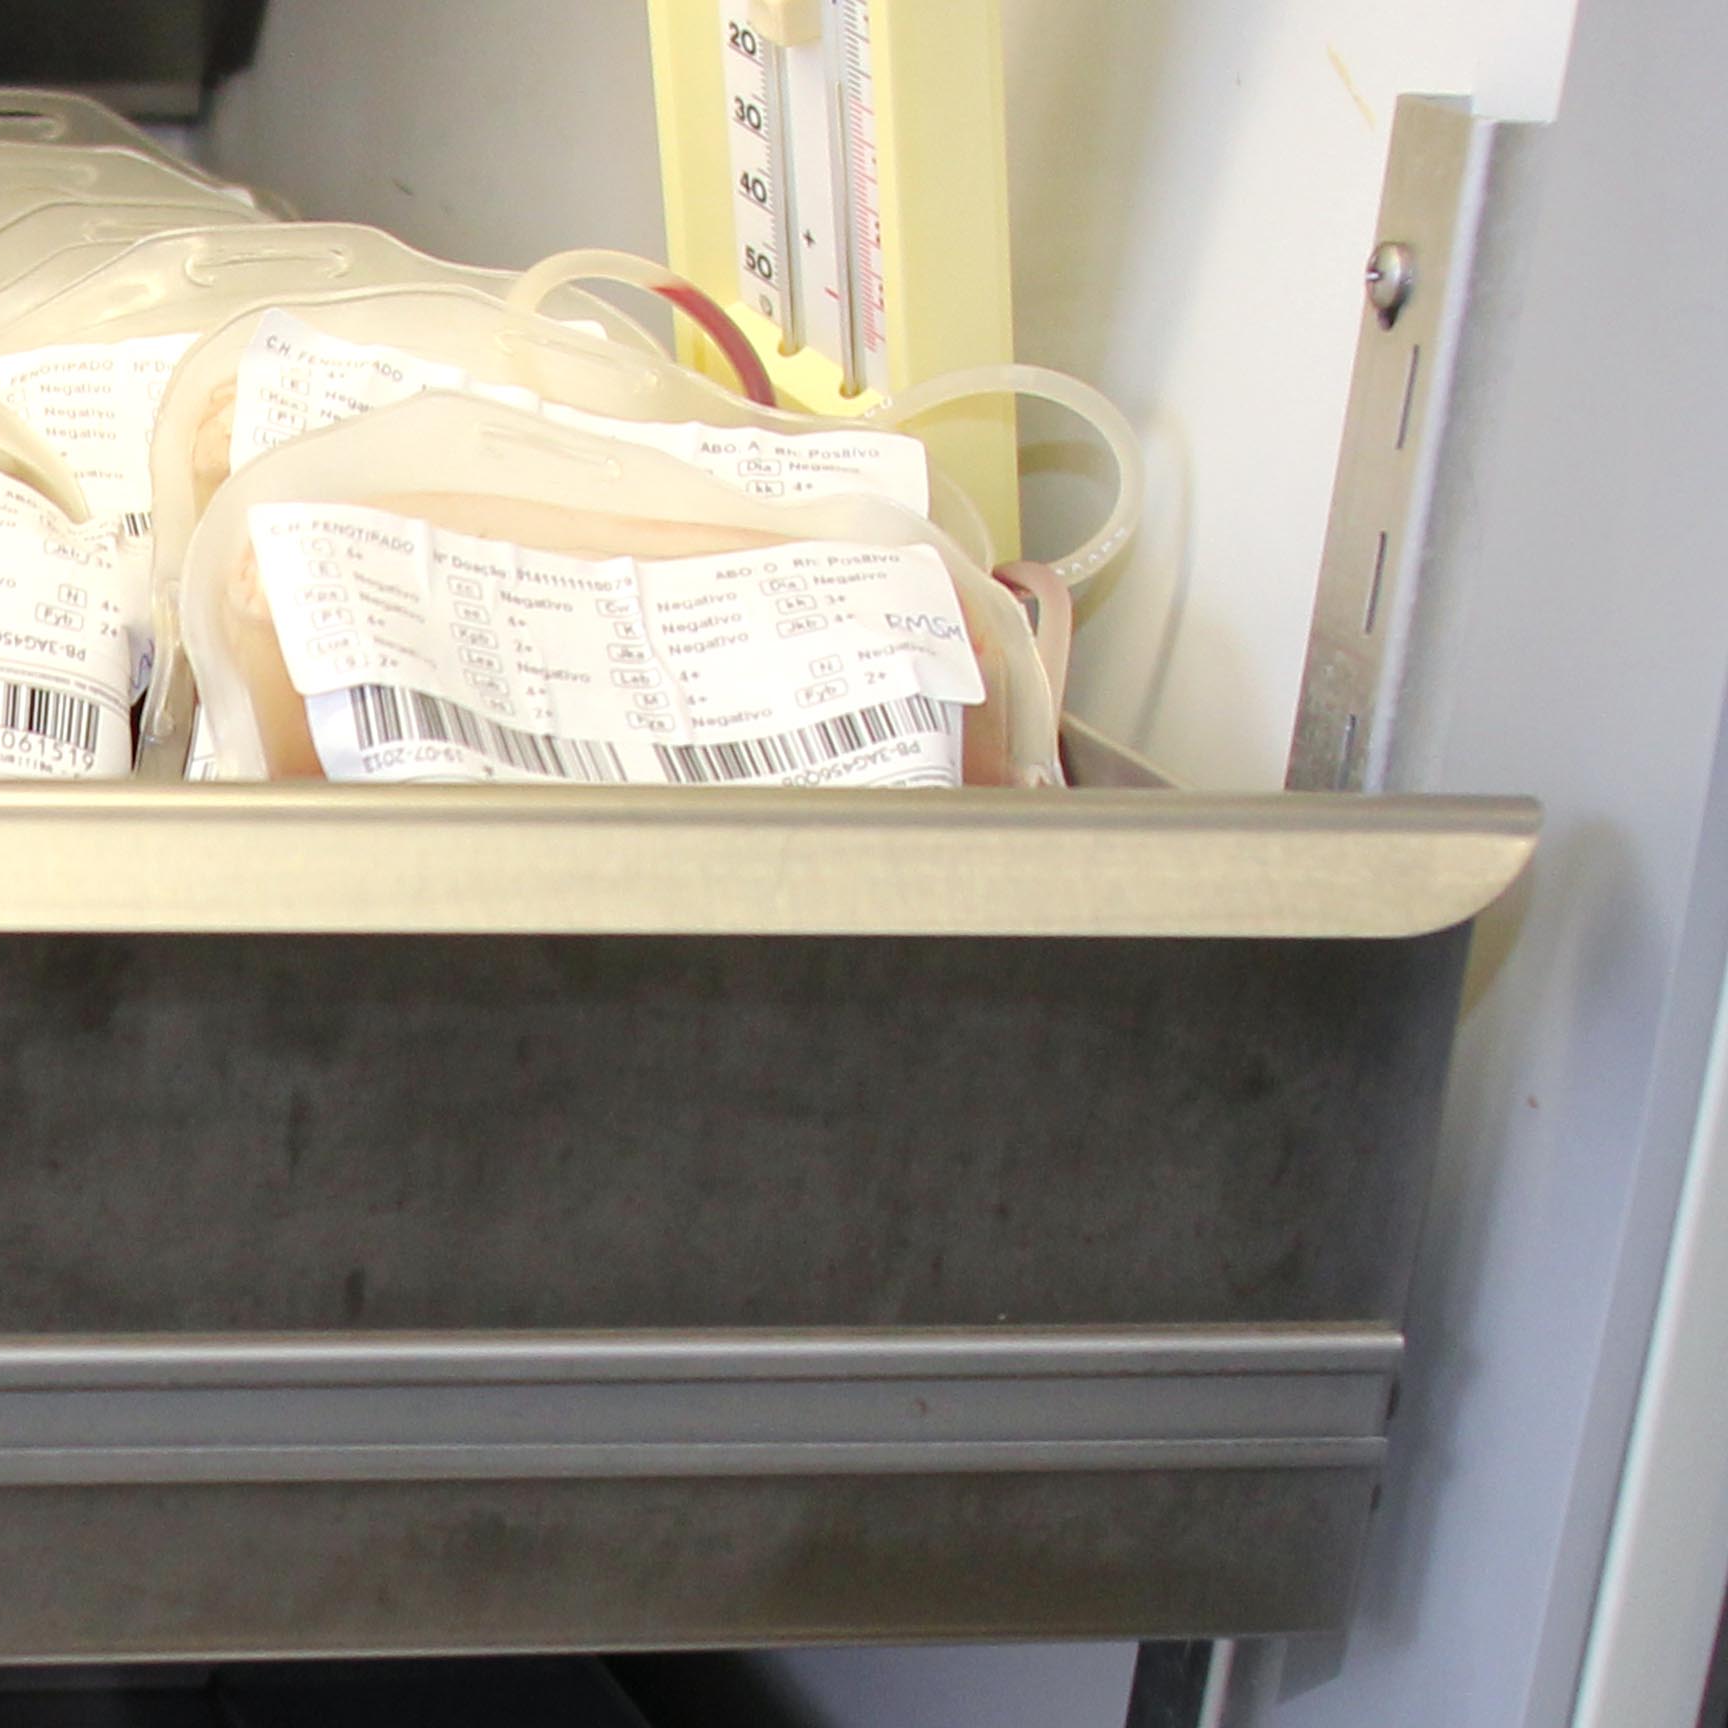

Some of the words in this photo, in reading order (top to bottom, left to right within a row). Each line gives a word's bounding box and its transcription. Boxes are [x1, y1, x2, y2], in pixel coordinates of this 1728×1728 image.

[728, 22, 756, 55] 20
[734, 96, 762, 130] 30
[740, 172, 767, 203] 40
[746, 246, 772, 280] 50
[312, 520, 415, 554] FENOTIPADO
[828, 553, 900, 567] Positivo
[814, 571, 887, 587] Negativo
[501, 590, 573, 612] Negativo
[657, 592, 737, 613] Negativo
[662, 613, 742, 635] Negativo
[669, 633, 749, 656] Negativo
[517, 662, 591, 682] Negativo
[693, 706, 773, 729] Negativo
